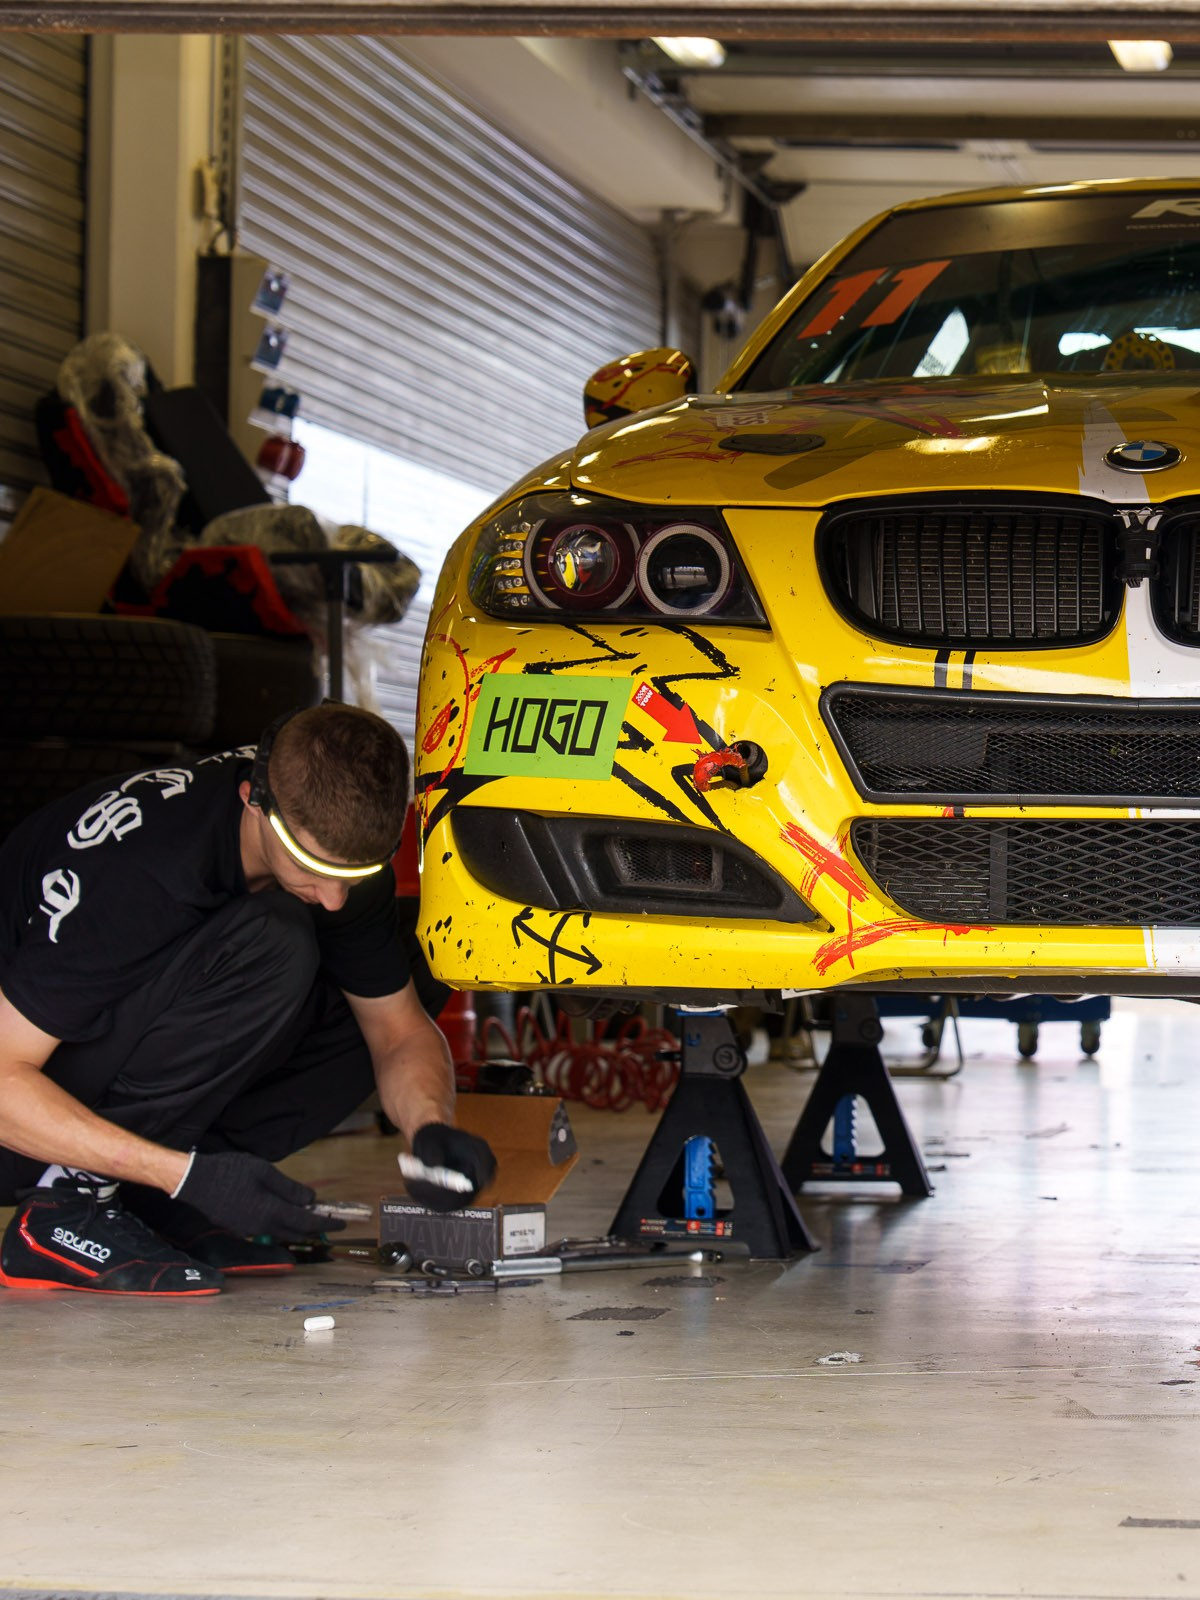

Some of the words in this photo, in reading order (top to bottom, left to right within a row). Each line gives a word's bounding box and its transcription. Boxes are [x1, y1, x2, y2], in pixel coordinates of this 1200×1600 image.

[797, 260, 952, 340] 11
[640, 689, 654, 707] TOW
[482, 696, 609, 757] HOGO
[383, 1205, 426, 1215] LEGENDARY
[465, 1210, 493, 1219] POWER
[52, 1227, 112, 1262] sparco
[381, 1215, 495, 1262] HAWK
